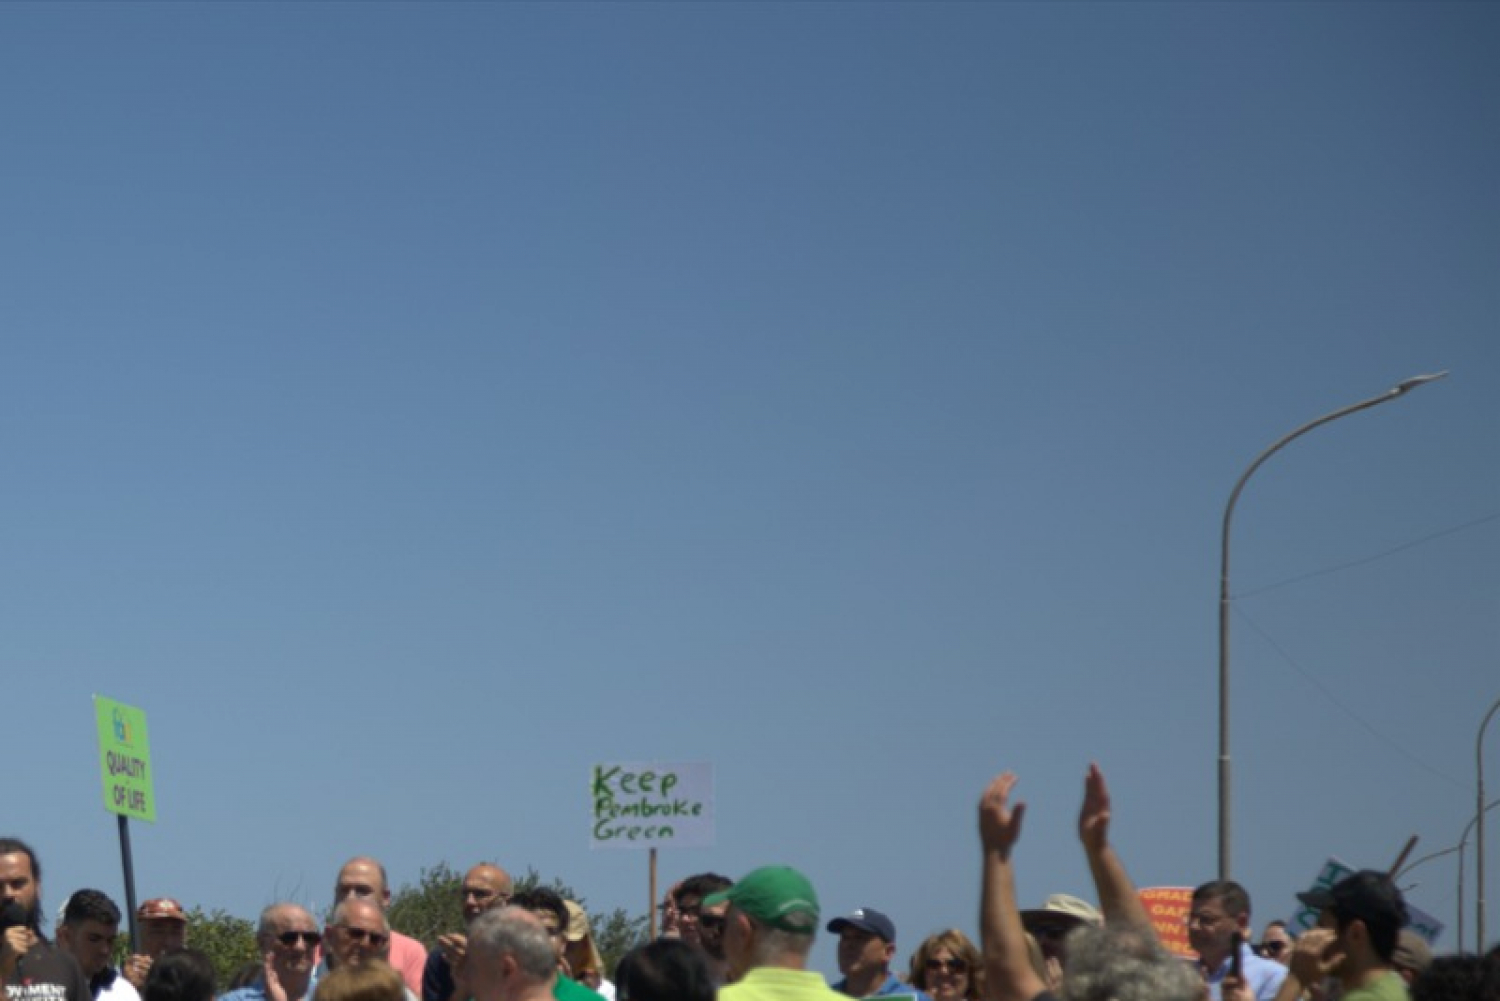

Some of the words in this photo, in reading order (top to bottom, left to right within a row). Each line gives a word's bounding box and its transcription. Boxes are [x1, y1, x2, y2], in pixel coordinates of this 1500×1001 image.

[593, 765, 678, 798] Keep
[595, 797, 703, 819] Pembroke
[593, 818, 674, 841] Green
